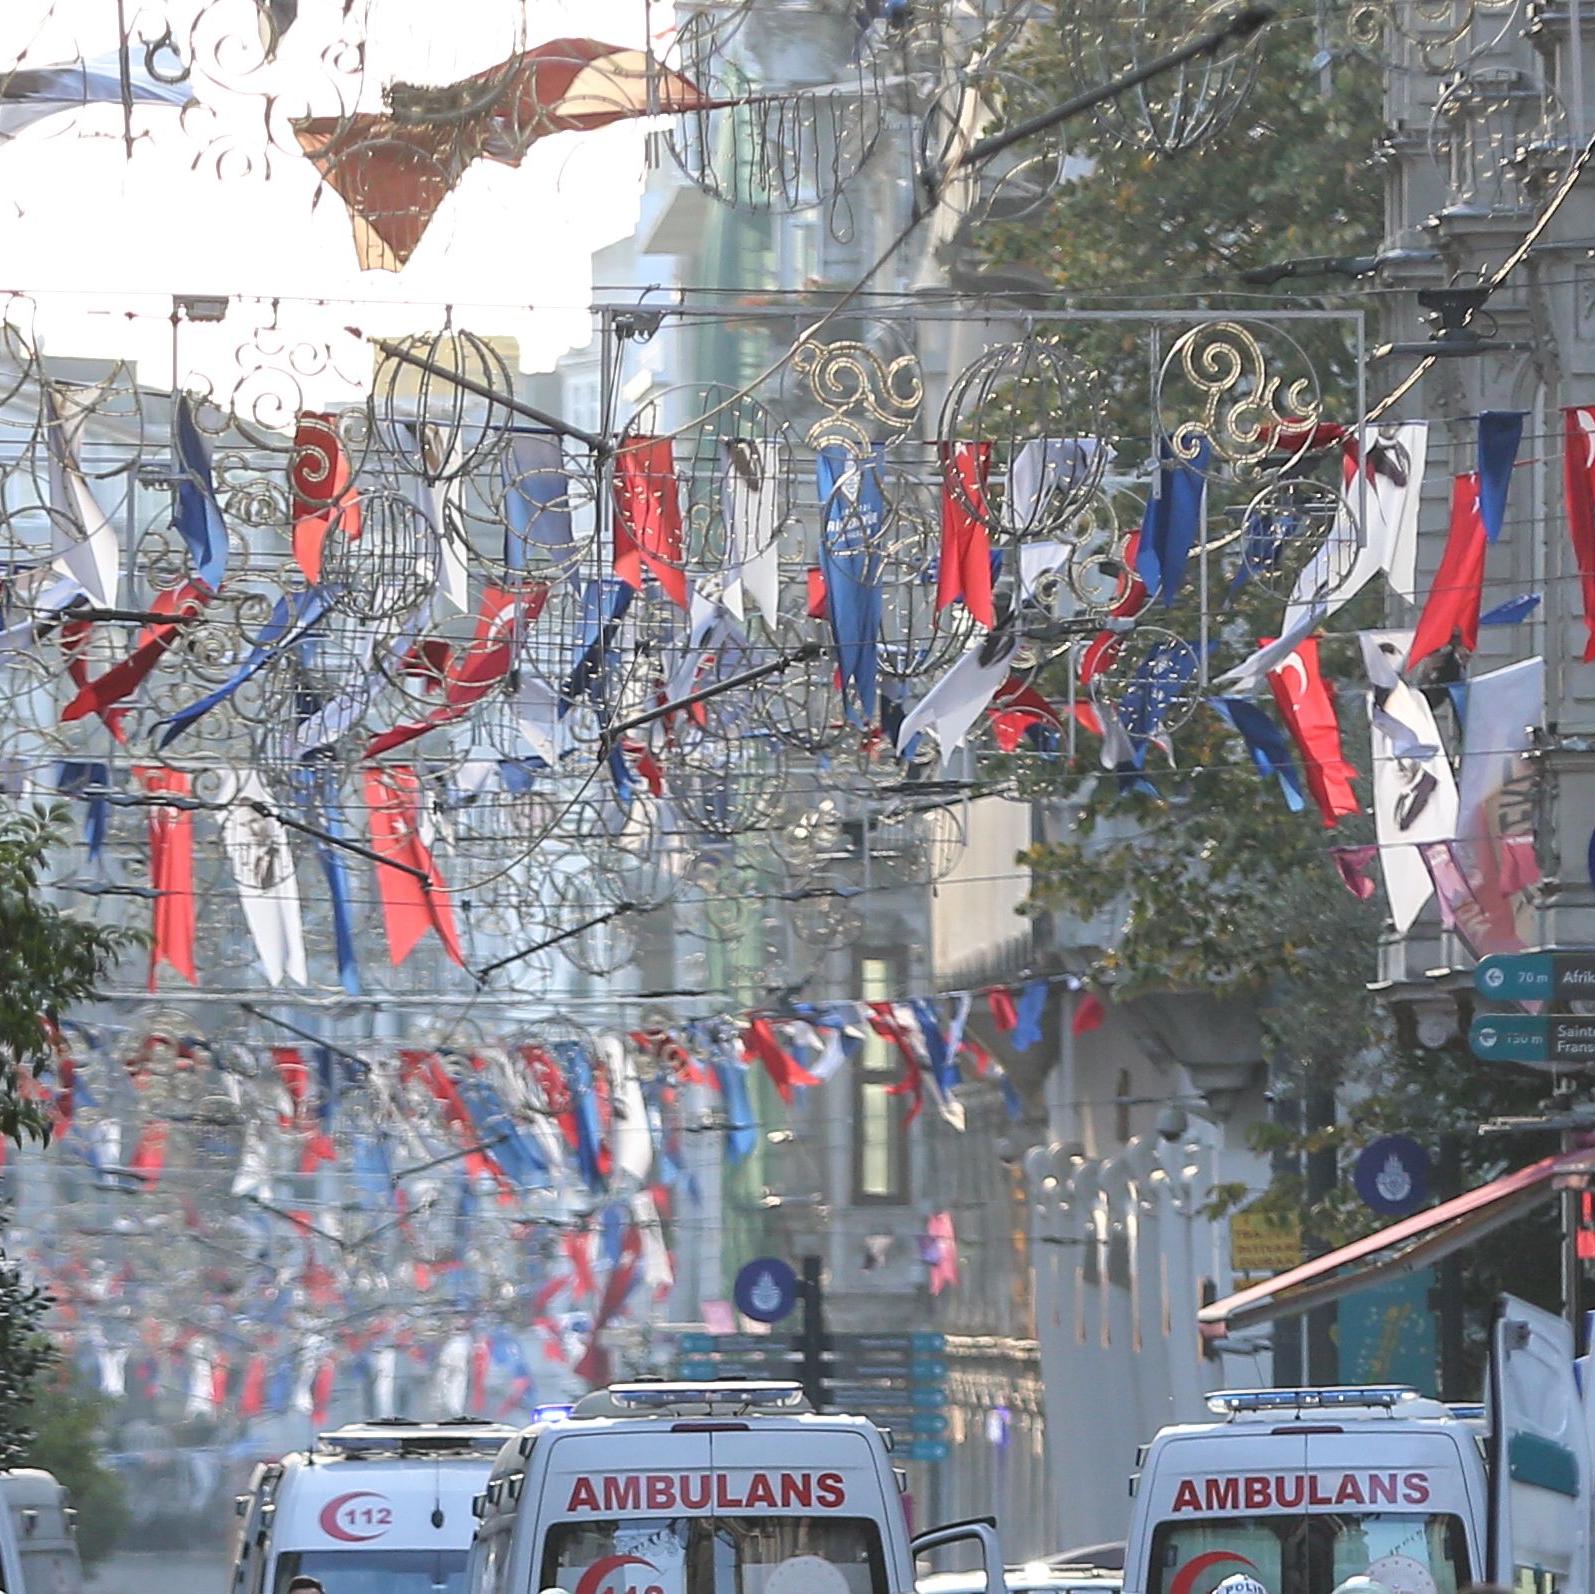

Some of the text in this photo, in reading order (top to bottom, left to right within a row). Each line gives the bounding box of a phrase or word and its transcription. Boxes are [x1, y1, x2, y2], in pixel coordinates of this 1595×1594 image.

[1518, 972, 1534, 984] 70
[1536, 974, 1548, 983] m
[1531, 1034, 1543, 1044] m
[565, 1472, 846, 1513] AMBULANS
[1171, 1472, 1431, 1513] AMBULANS
[344, 1507, 392, 1525] 112
